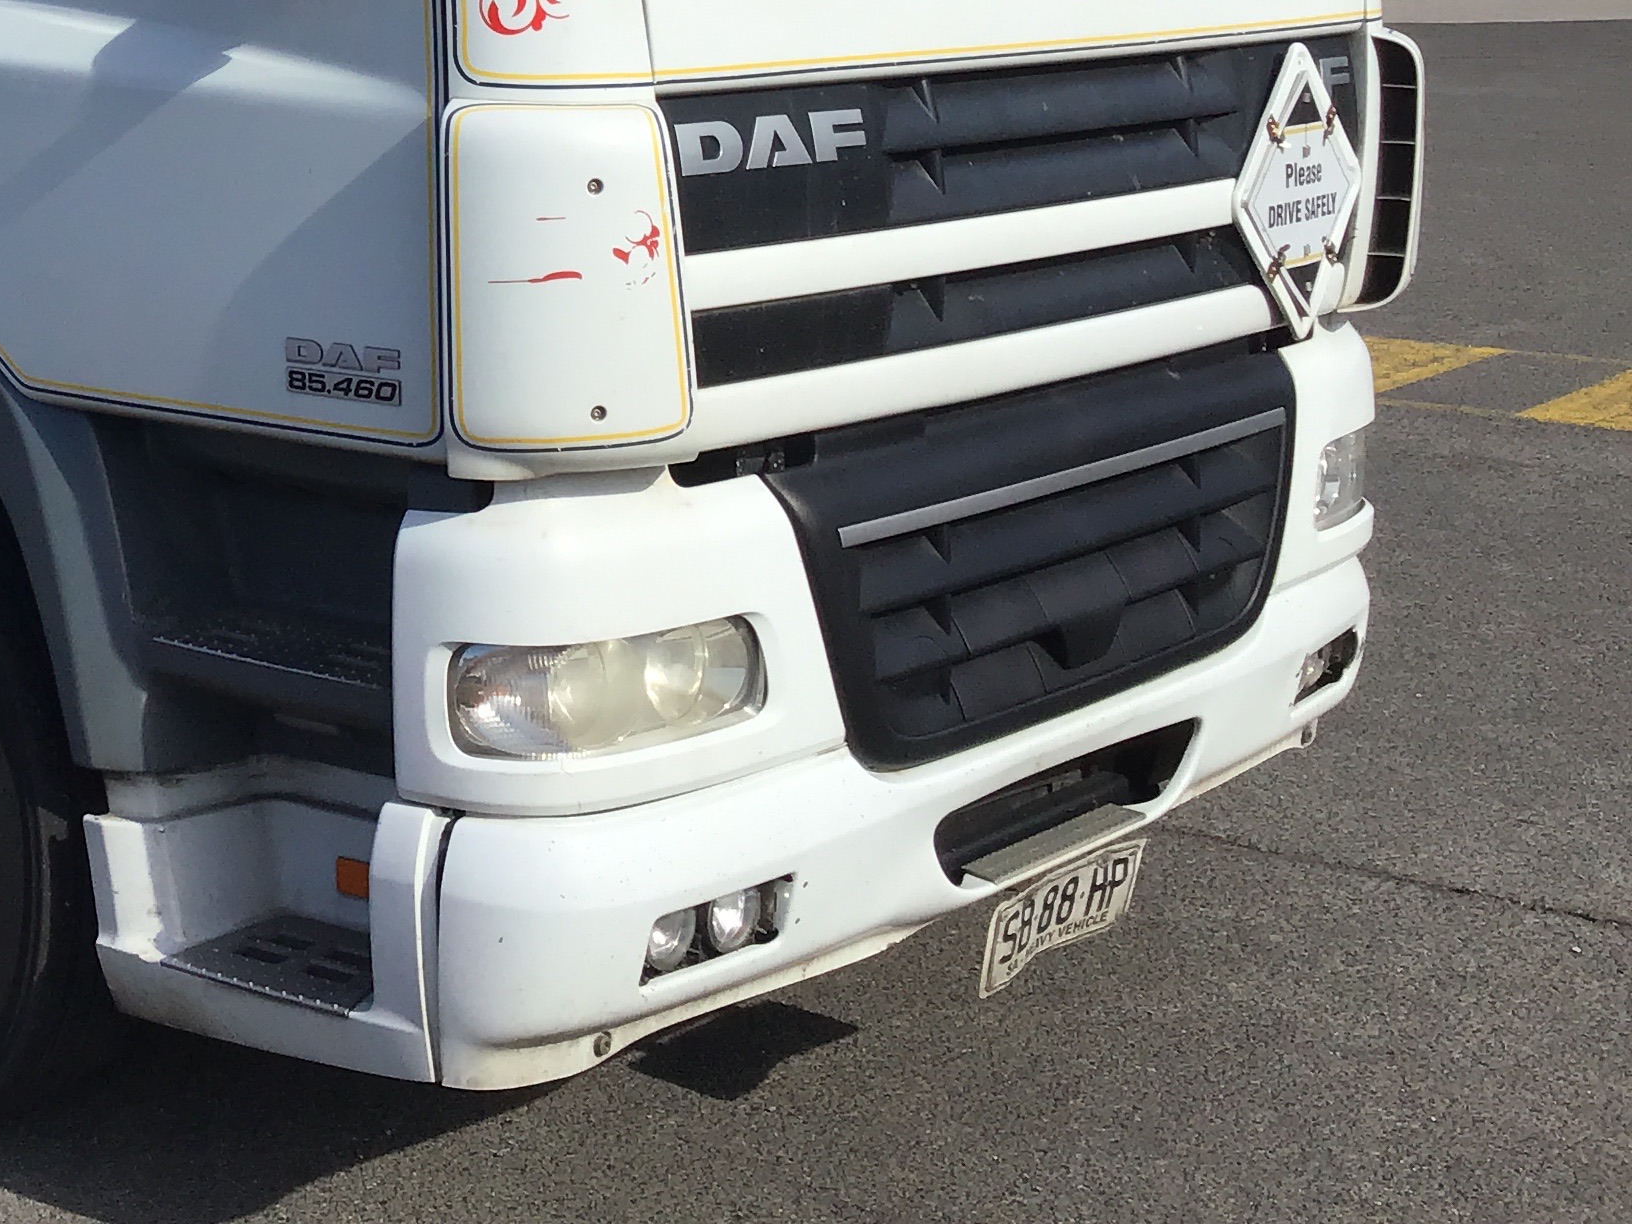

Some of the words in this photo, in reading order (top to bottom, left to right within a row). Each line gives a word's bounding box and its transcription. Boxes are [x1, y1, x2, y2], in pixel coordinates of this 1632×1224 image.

[673, 108, 867, 177] DAF
[1285, 162, 1322, 189] Please
[1268, 200, 1302, 229] DRIVE
[1304, 191, 1337, 222] SAFELY
[285, 336, 401, 374] DAF
[287, 369, 398, 403] 85.460
[1058, 910, 1110, 939] VEHICLE
